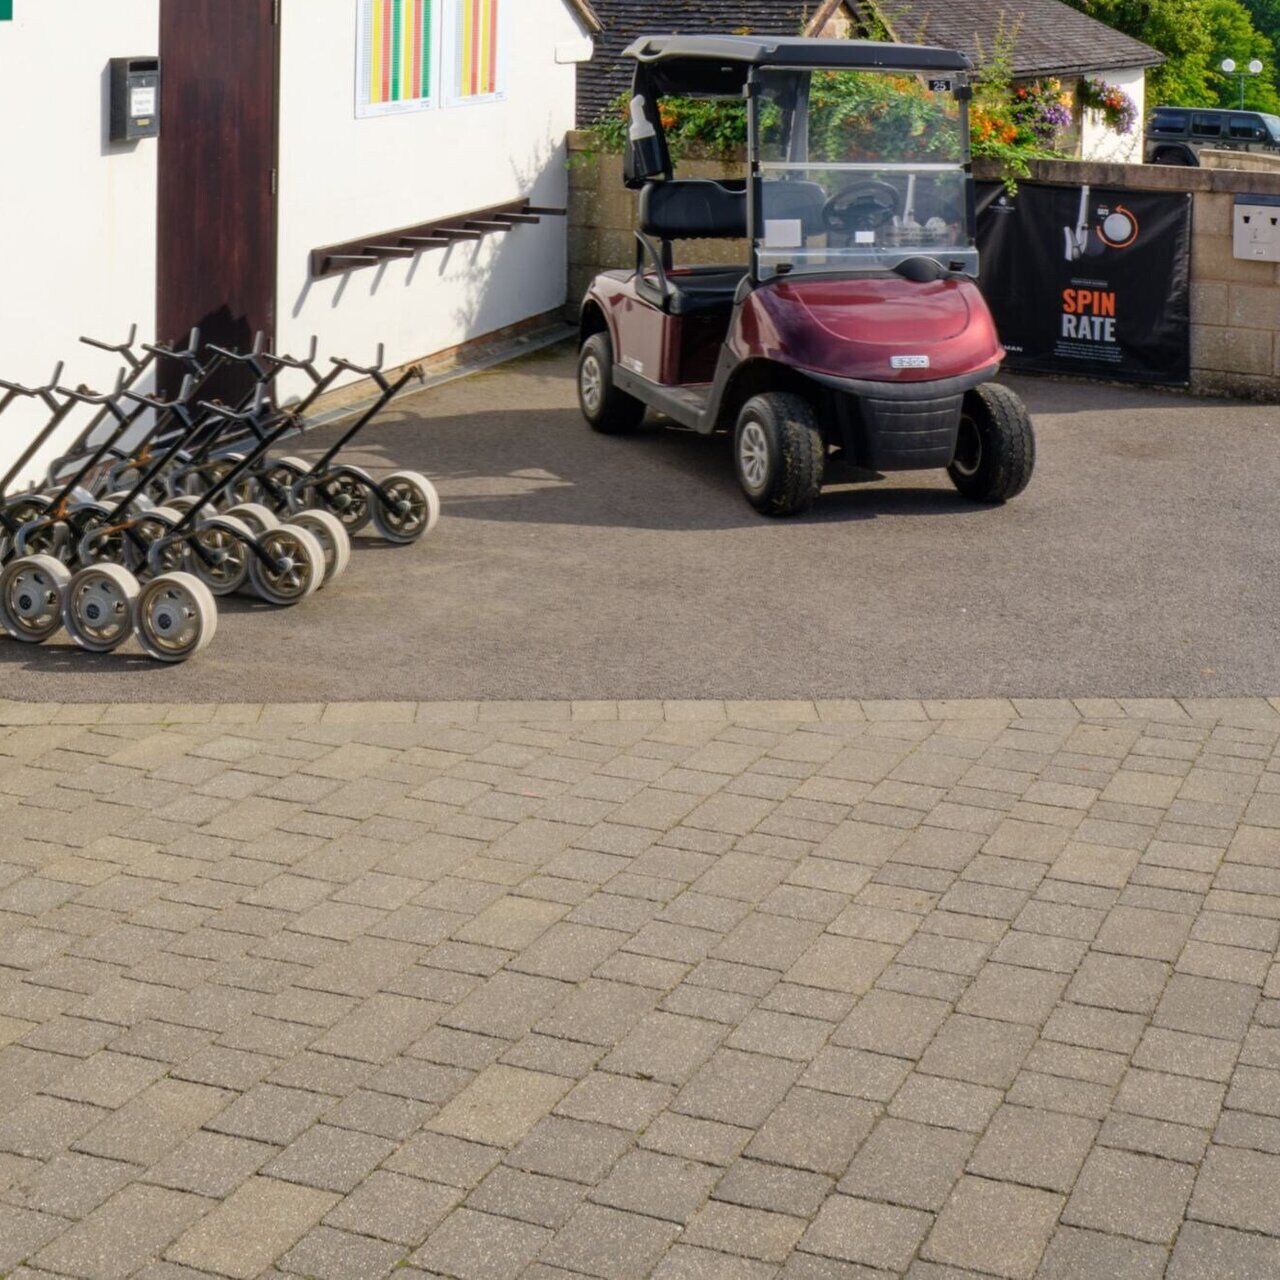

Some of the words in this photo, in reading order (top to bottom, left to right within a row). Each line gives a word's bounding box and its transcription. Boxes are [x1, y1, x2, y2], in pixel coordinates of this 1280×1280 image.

[933, 80, 947, 91] 25
[1062, 288, 1116, 317] SPIN
[1062, 313, 1117, 342] RATE
